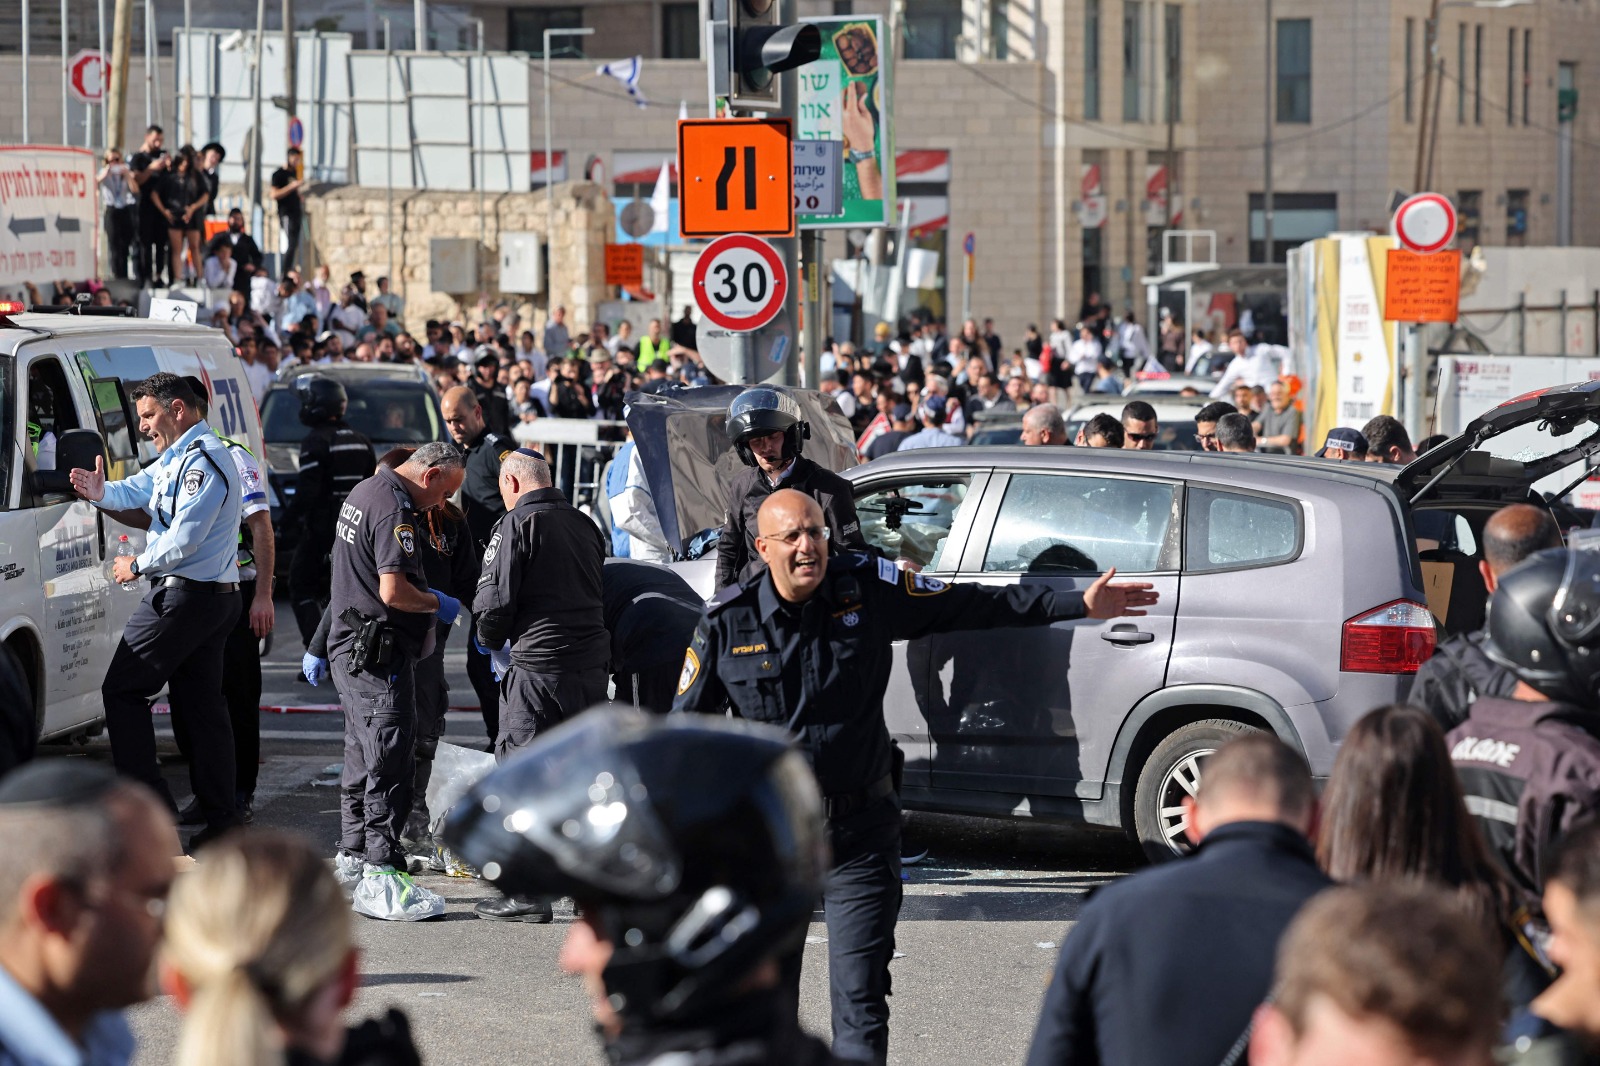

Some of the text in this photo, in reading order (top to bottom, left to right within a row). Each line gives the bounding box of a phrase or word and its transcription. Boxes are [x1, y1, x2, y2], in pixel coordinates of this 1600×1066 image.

[713, 262, 767, 304] 30
[1329, 440, 1353, 449] POLICE
[56, 557, 92, 574] SEARCH AND RESCUE
